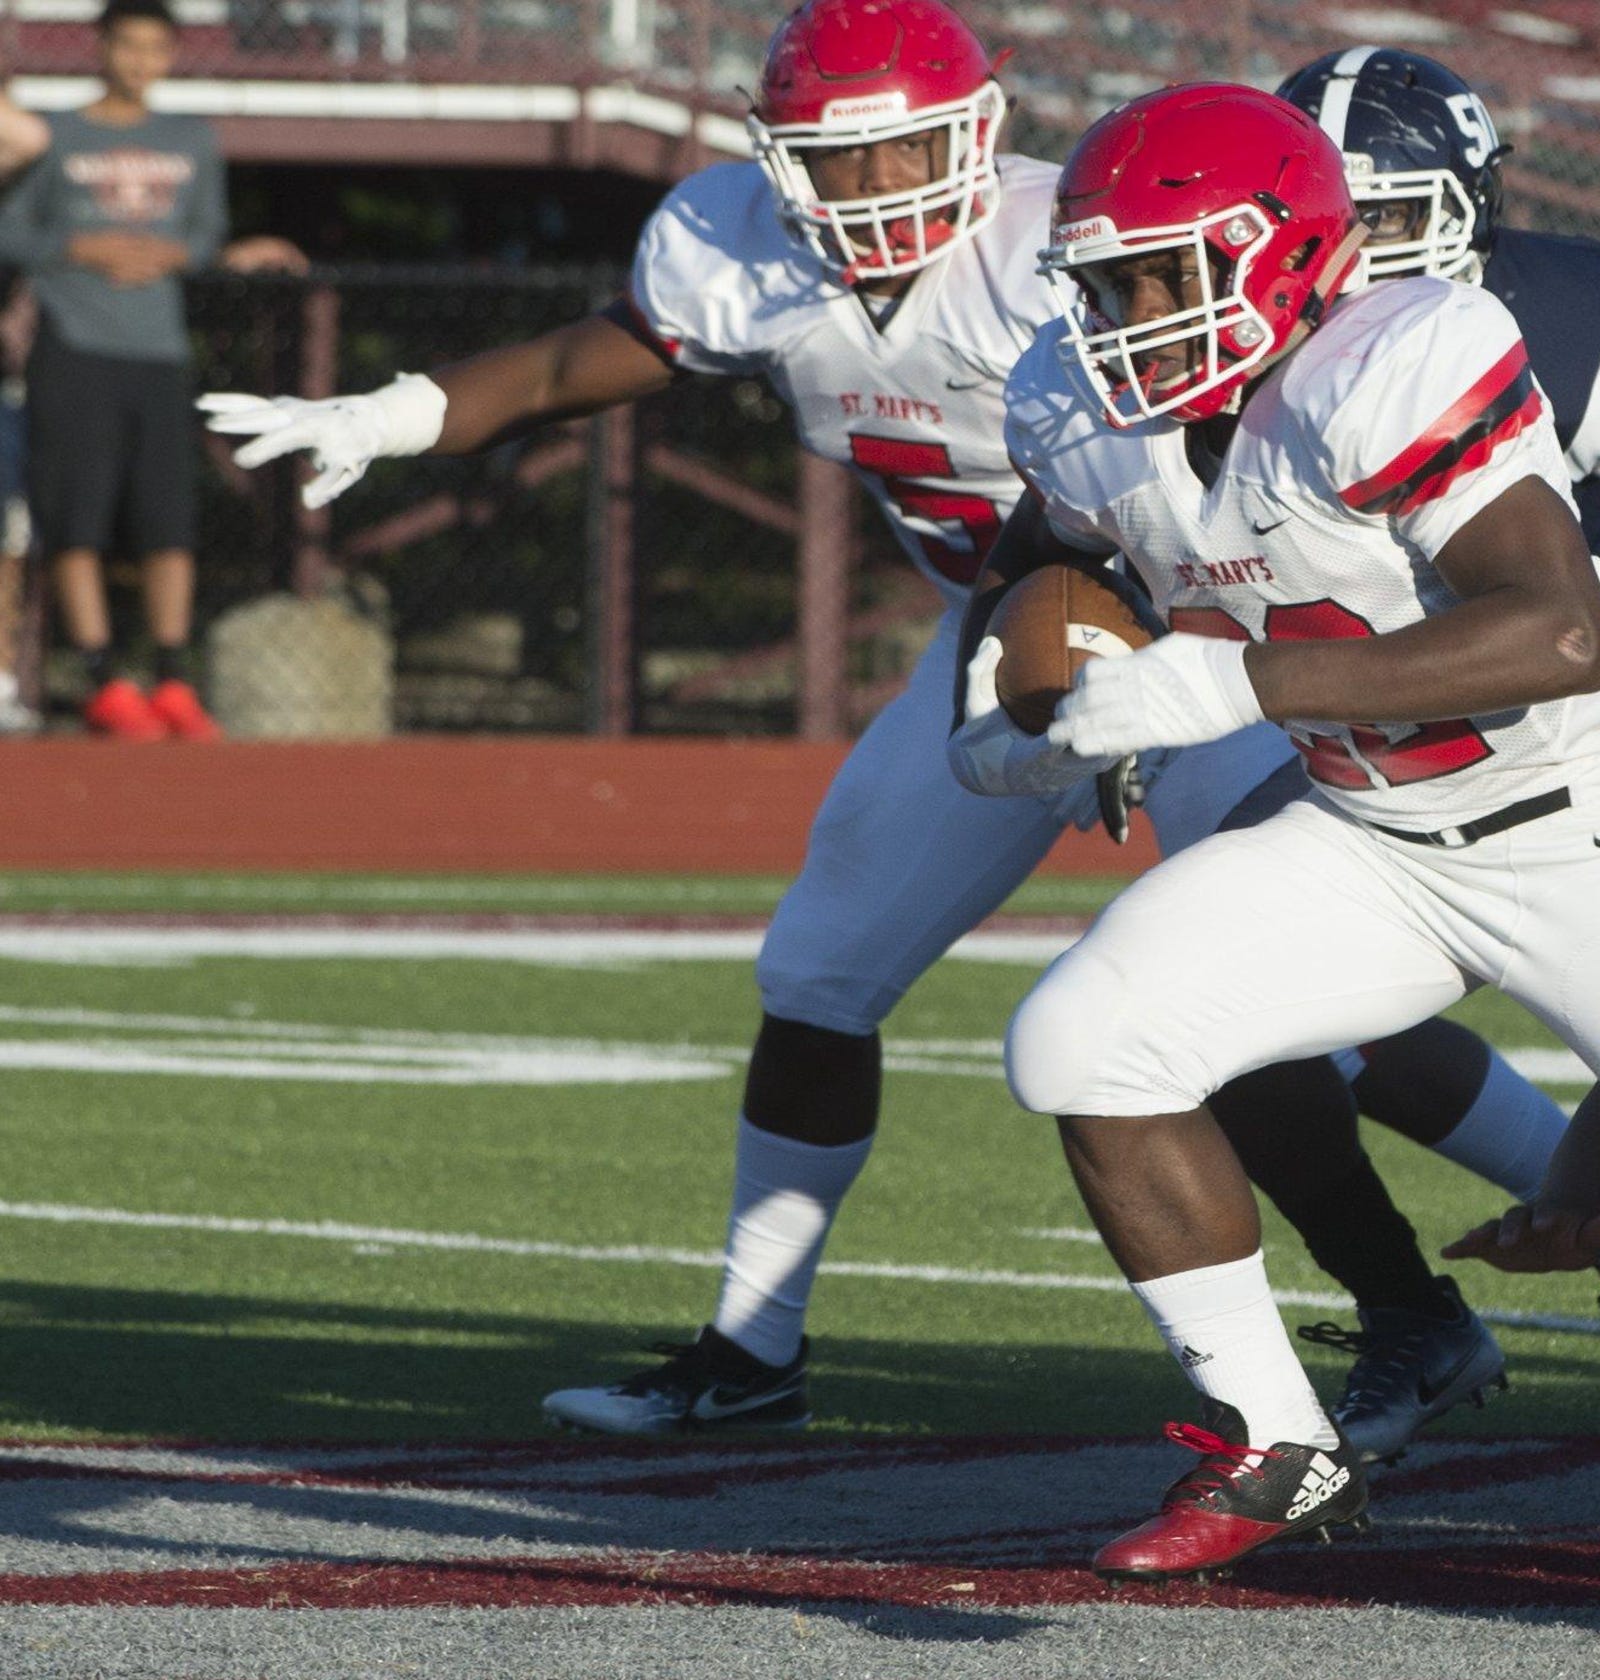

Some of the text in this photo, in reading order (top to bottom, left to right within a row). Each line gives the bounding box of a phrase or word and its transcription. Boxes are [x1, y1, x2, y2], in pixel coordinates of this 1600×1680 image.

[848, 431, 1004, 586] 5
[1175, 556, 1276, 588] ST. MARY'S
[1285, 1465, 1351, 1521] adidas
